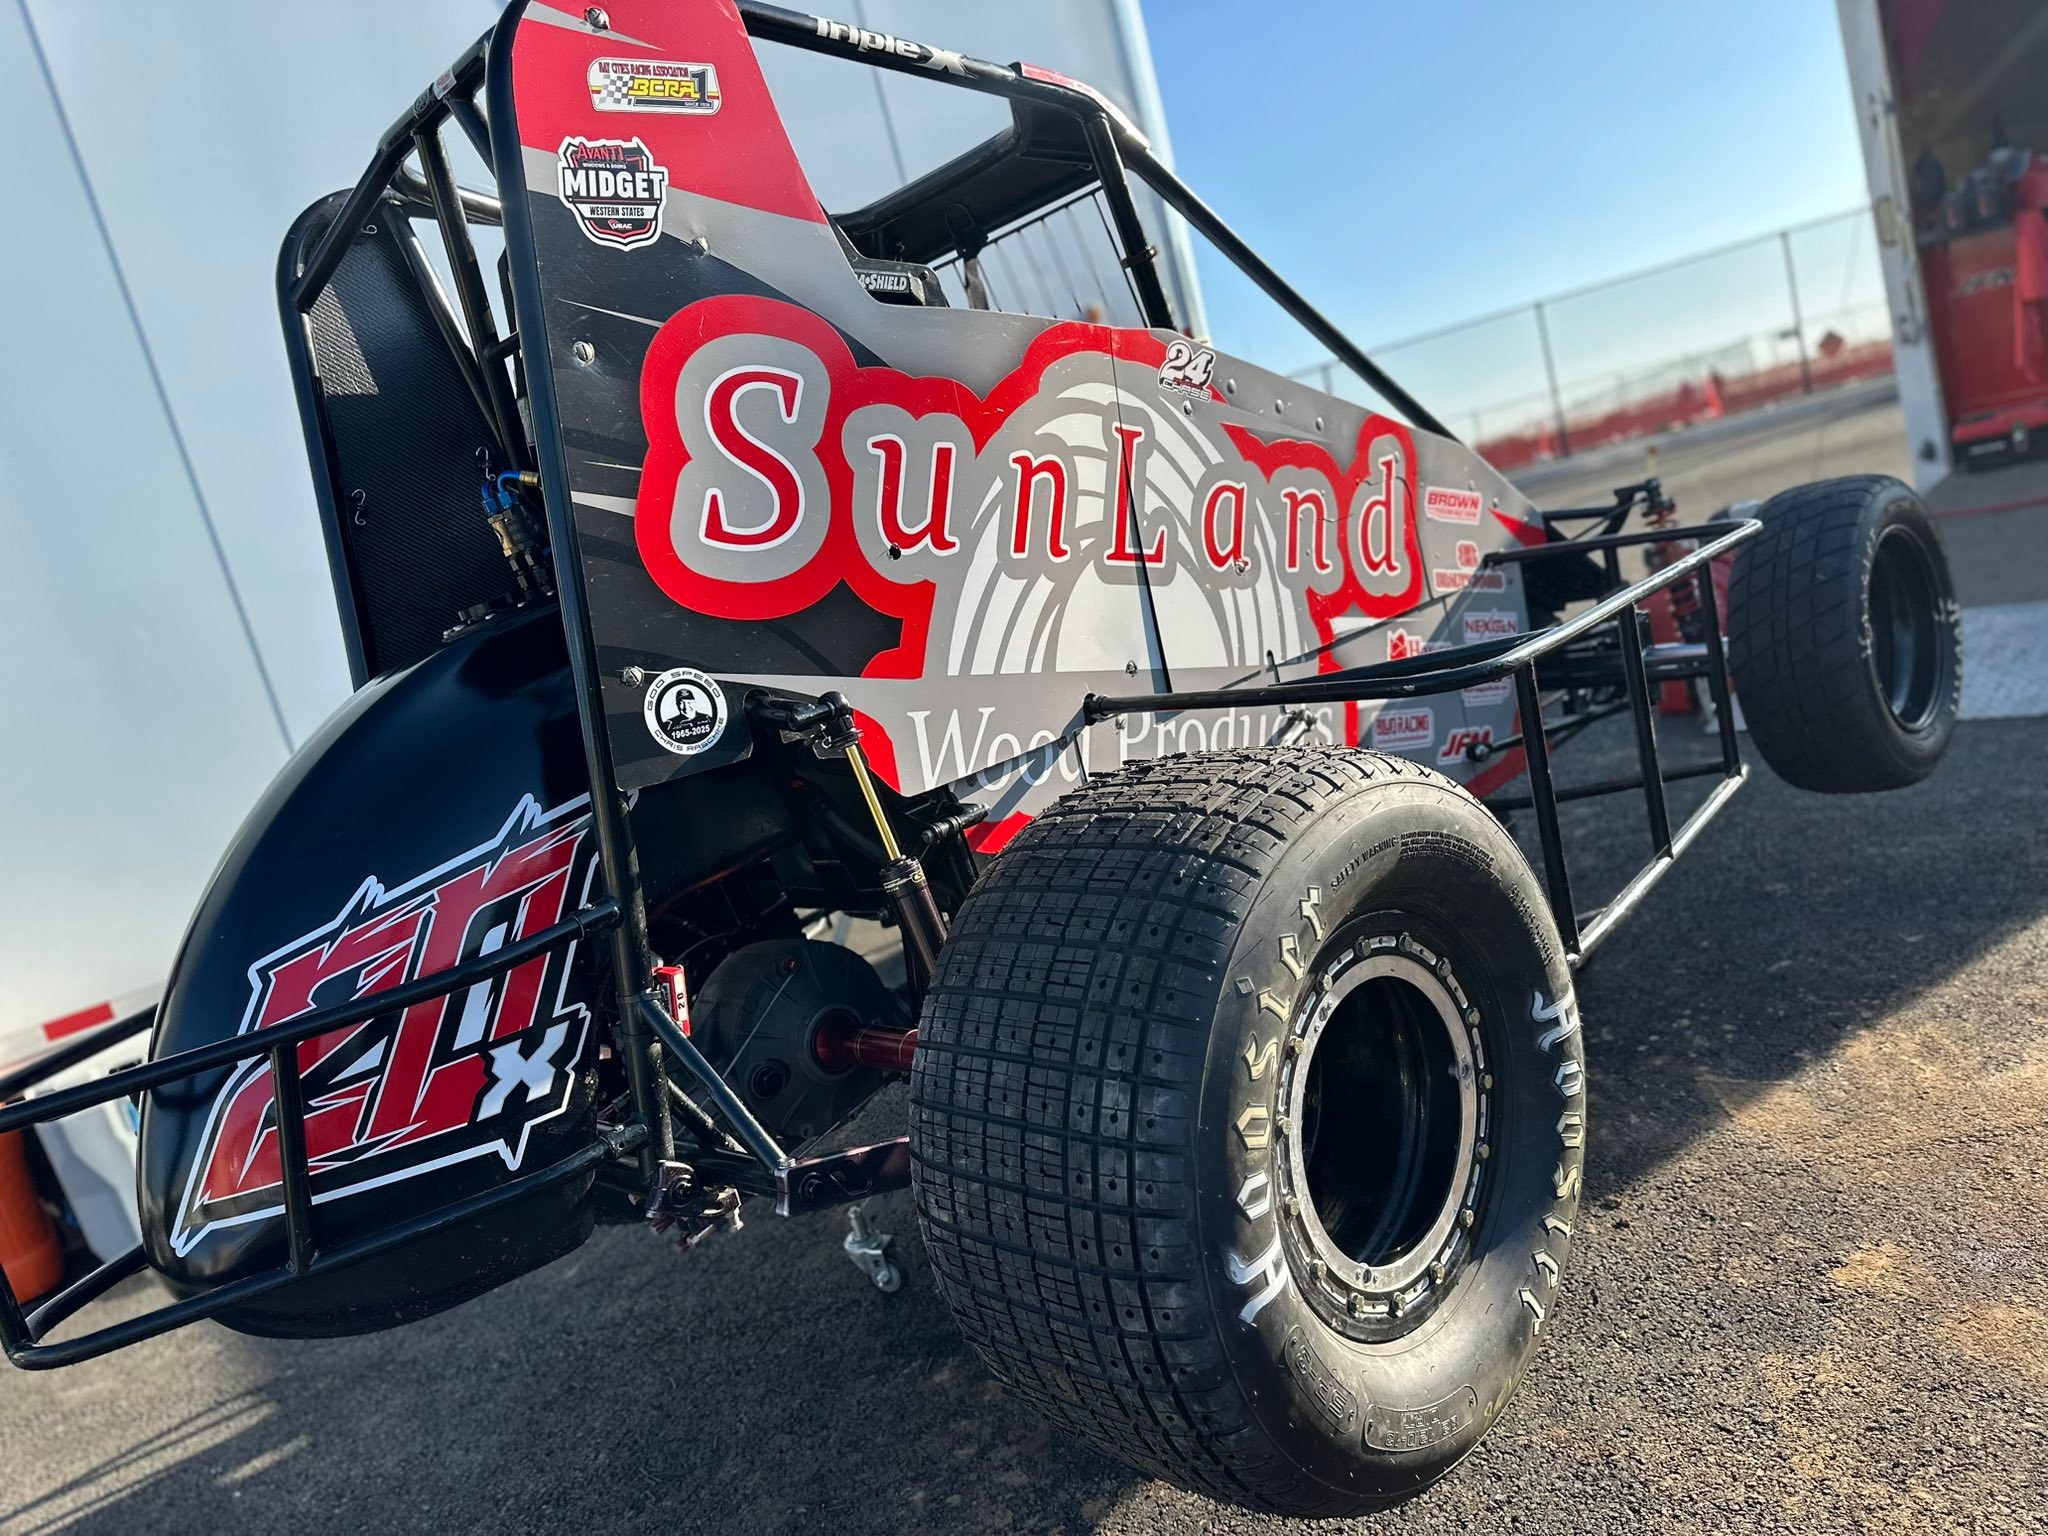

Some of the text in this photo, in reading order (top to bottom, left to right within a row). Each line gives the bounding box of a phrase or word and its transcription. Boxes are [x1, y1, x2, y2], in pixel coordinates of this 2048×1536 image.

[611, 63, 630, 75] CITIES
[630, 64, 652, 76] RACING
[652, 65, 689, 78] ASSOCIATION
[627, 78, 700, 98] BCRA
[577, 141, 624, 161] AVANTI
[564, 169, 664, 198] MIDGET
[590, 206, 645, 217] WESTERN STATES
[868, 273, 907, 291] SHIELD
[1160, 341, 1213, 387] 24
[1162, 378, 1211, 402] CHASE
[699, 365, 1401, 577] SunLand
[1428, 492, 1479, 510] BROWN
[670, 670, 721, 699] SPEED
[654, 717, 724, 752] CHRIS RASCHKE
[671, 724, 710, 740] 1965-2025
[1119, 706, 1334, 768] Produs
[907, 706, 1091, 794] Wood
[1331, 855, 1361, 892] SAFETY
[1224, 885, 1326, 1325] Hoosier
[1519, 979, 1584, 1336] Hoosier
